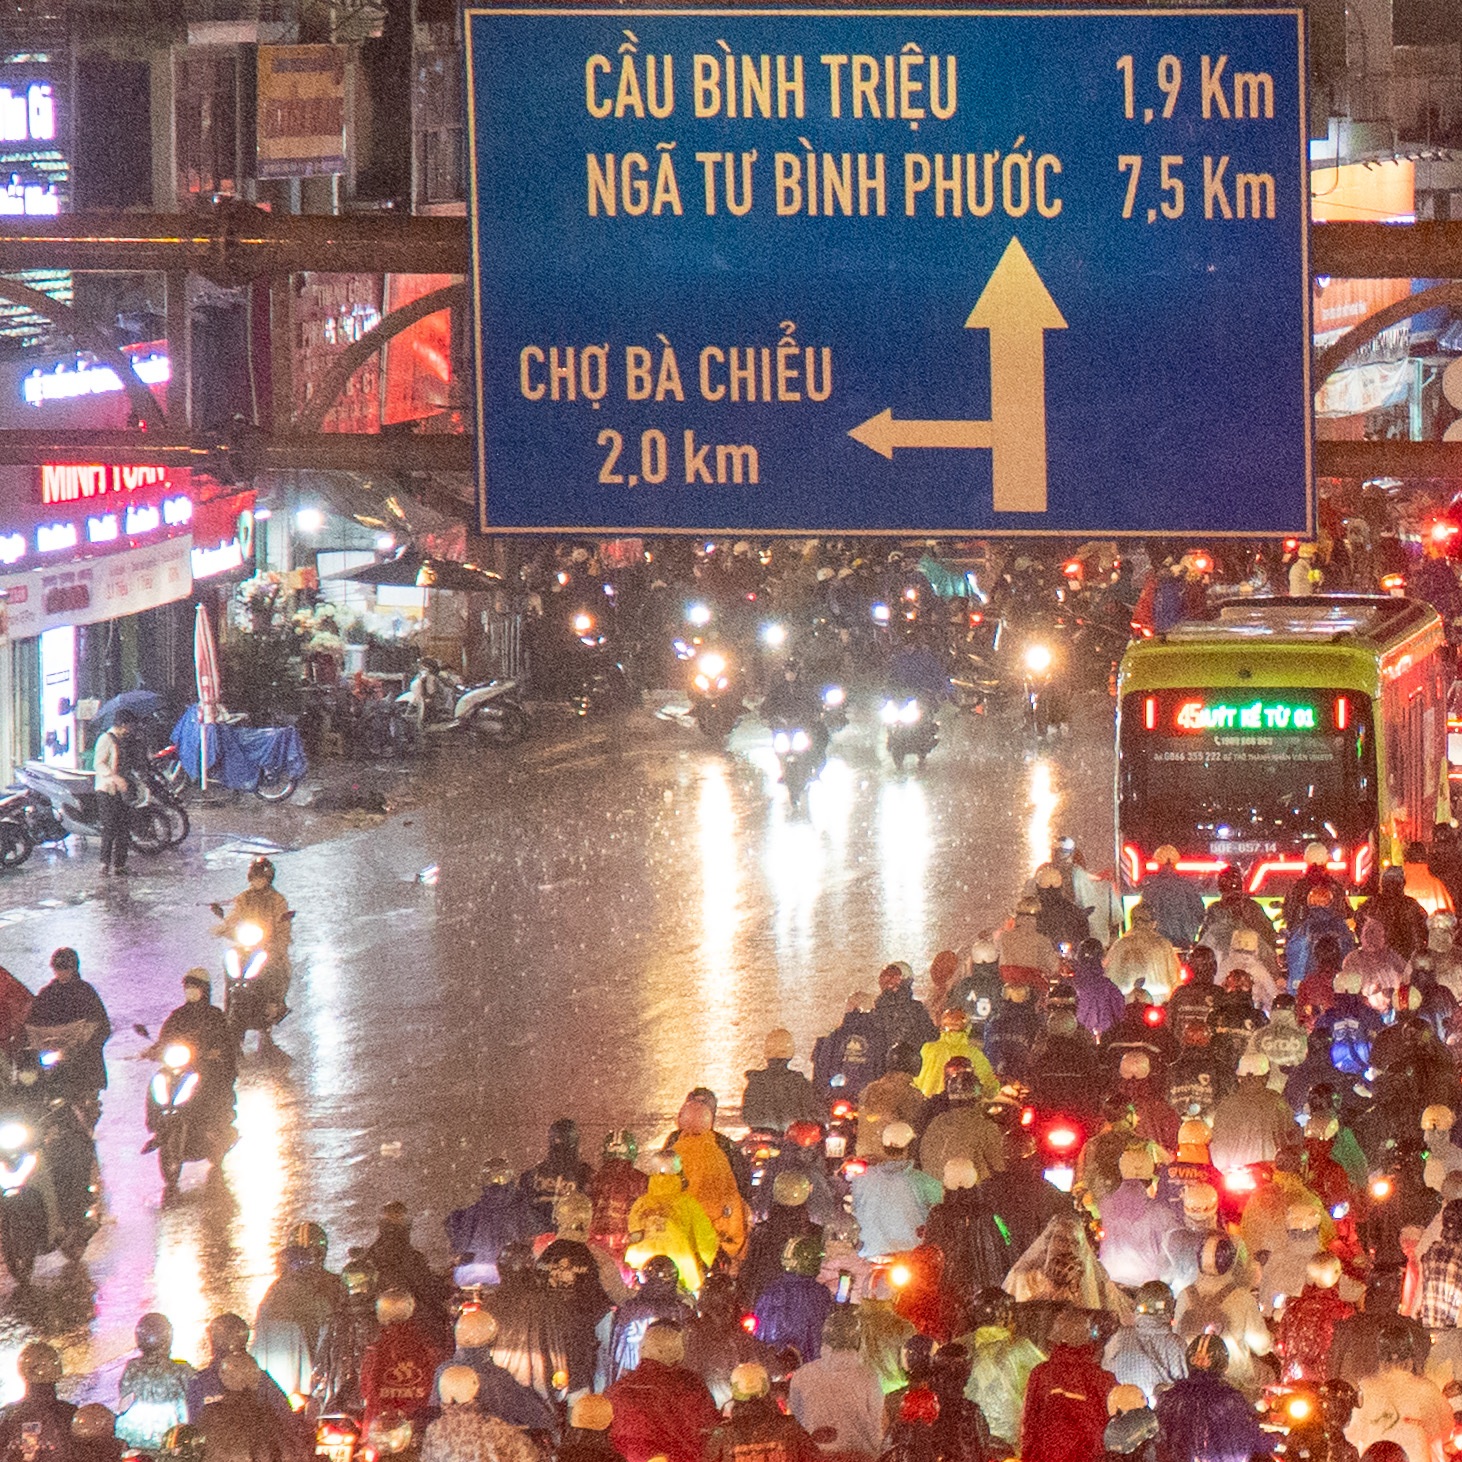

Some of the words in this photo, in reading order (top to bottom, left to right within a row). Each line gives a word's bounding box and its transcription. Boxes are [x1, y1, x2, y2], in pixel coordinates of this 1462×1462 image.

[585, 29, 674, 119] CẦU
[693, 39, 804, 119] BÌNH
[820, 42, 957, 130] TRIỆU
[1116, 55, 1182, 124] 1,9
[1201, 55, 1274, 119] Km
[586, 141, 683, 217] NGÃ
[695, 148, 758, 217] TƯ
[774, 137, 885, 217] BÌNH
[904, 135, 1062, 218] PHƯỚC
[1118, 154, 1185, 224] 7,5
[1203, 156, 1276, 220] Km
[519, 343, 609, 409] CHỢ
[626, 333, 685, 402] BÀ
[699, 321, 832, 402] CHIỂU
[597, 429, 667, 488] 2,0
[684, 429, 760, 485] km
[1176, 703, 1204, 729] 45
[1261, 1036, 1301, 1051] Grab
